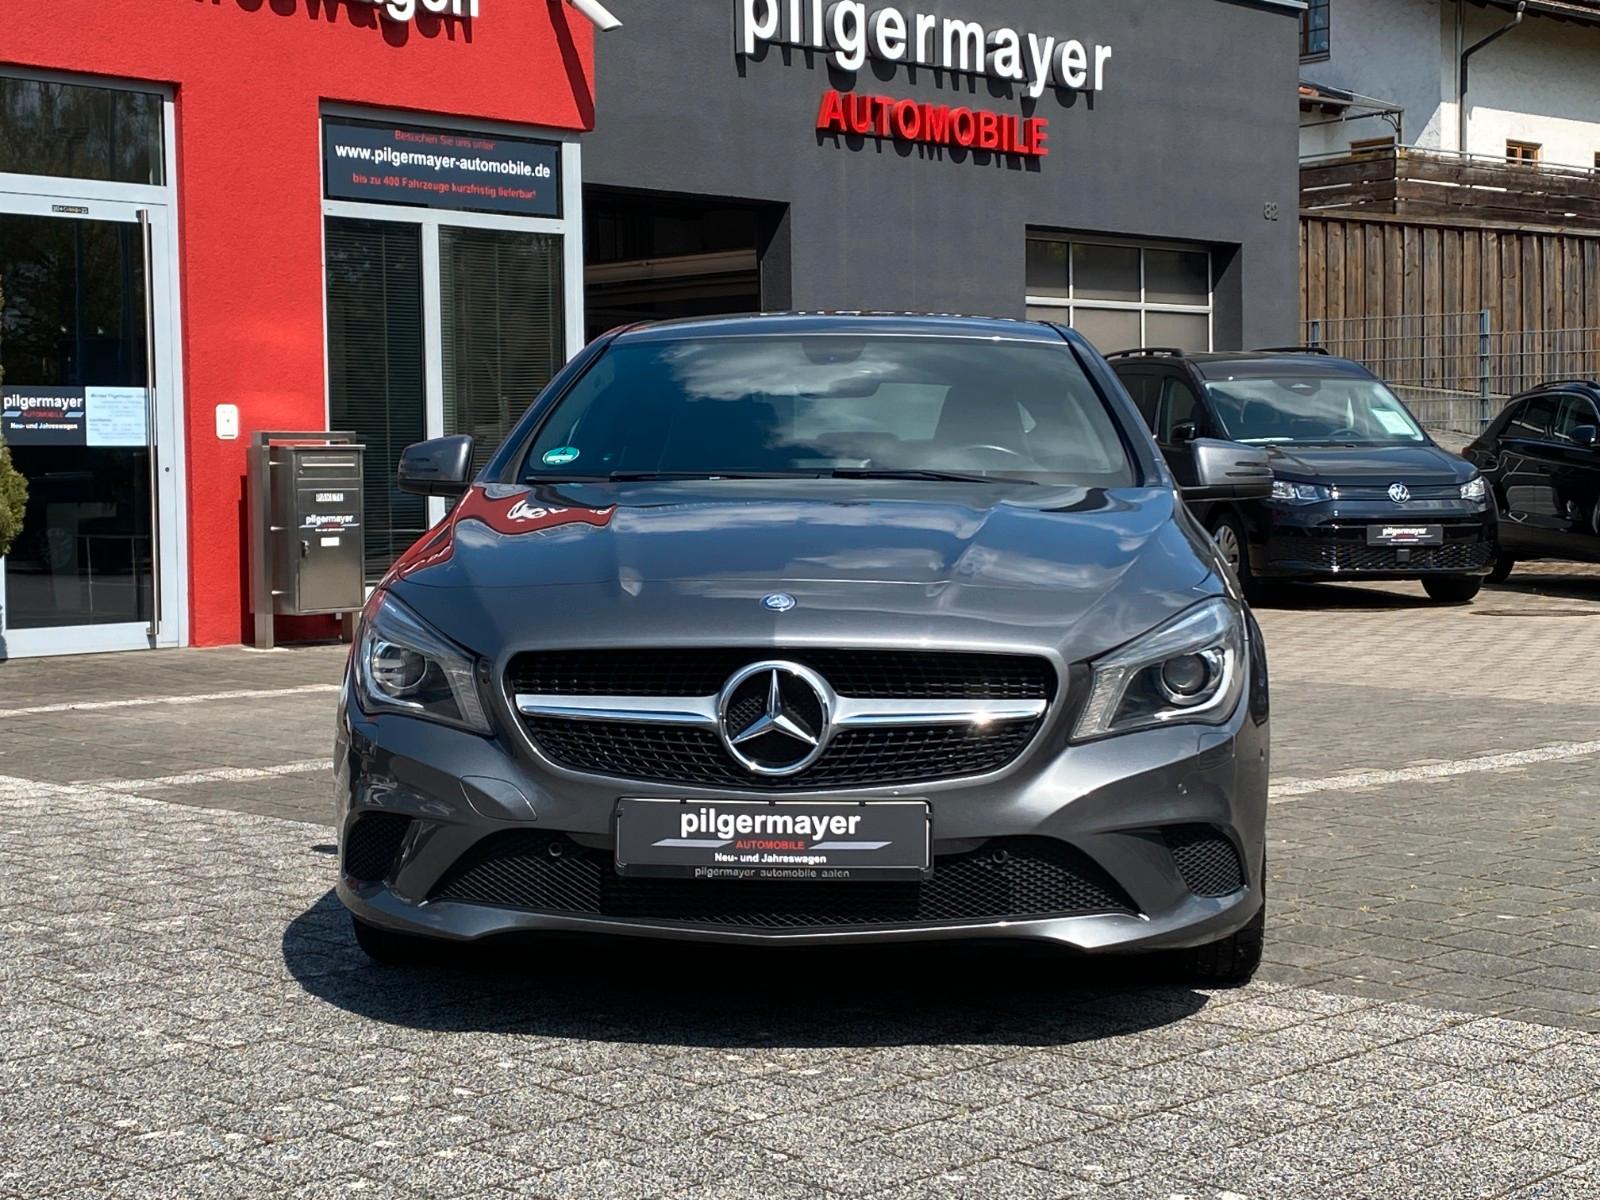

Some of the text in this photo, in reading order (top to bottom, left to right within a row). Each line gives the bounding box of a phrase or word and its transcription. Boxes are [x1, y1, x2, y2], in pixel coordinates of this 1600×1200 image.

[743, 0, 1112, 98] pilgermayer
[816, 89, 1049, 156] AUTOMOBILE
[394, 129, 495, 151] Besuchen Sie uns unter
[335, 144, 551, 178] www.pilgermayer-automobile.de
[352, 172, 368, 184] bis
[369, 175, 381, 185] zu
[383, 175, 400, 187] 400
[401, 177, 450, 193] Fahrzeuge
[451, 182, 496, 198] kurzfristig
[1263, 201, 1279, 221] 82
[3, 394, 83, 410] pilgermayer
[305, 514, 353, 525] pilgermayer
[680, 807, 861, 840] pilgermayer
[735, 839, 806, 850] AUTOMOBILE
[714, 852, 827, 865] Neu- und Jahreswagen
[694, 867, 850, 879] pilgermayer automobile aalen
